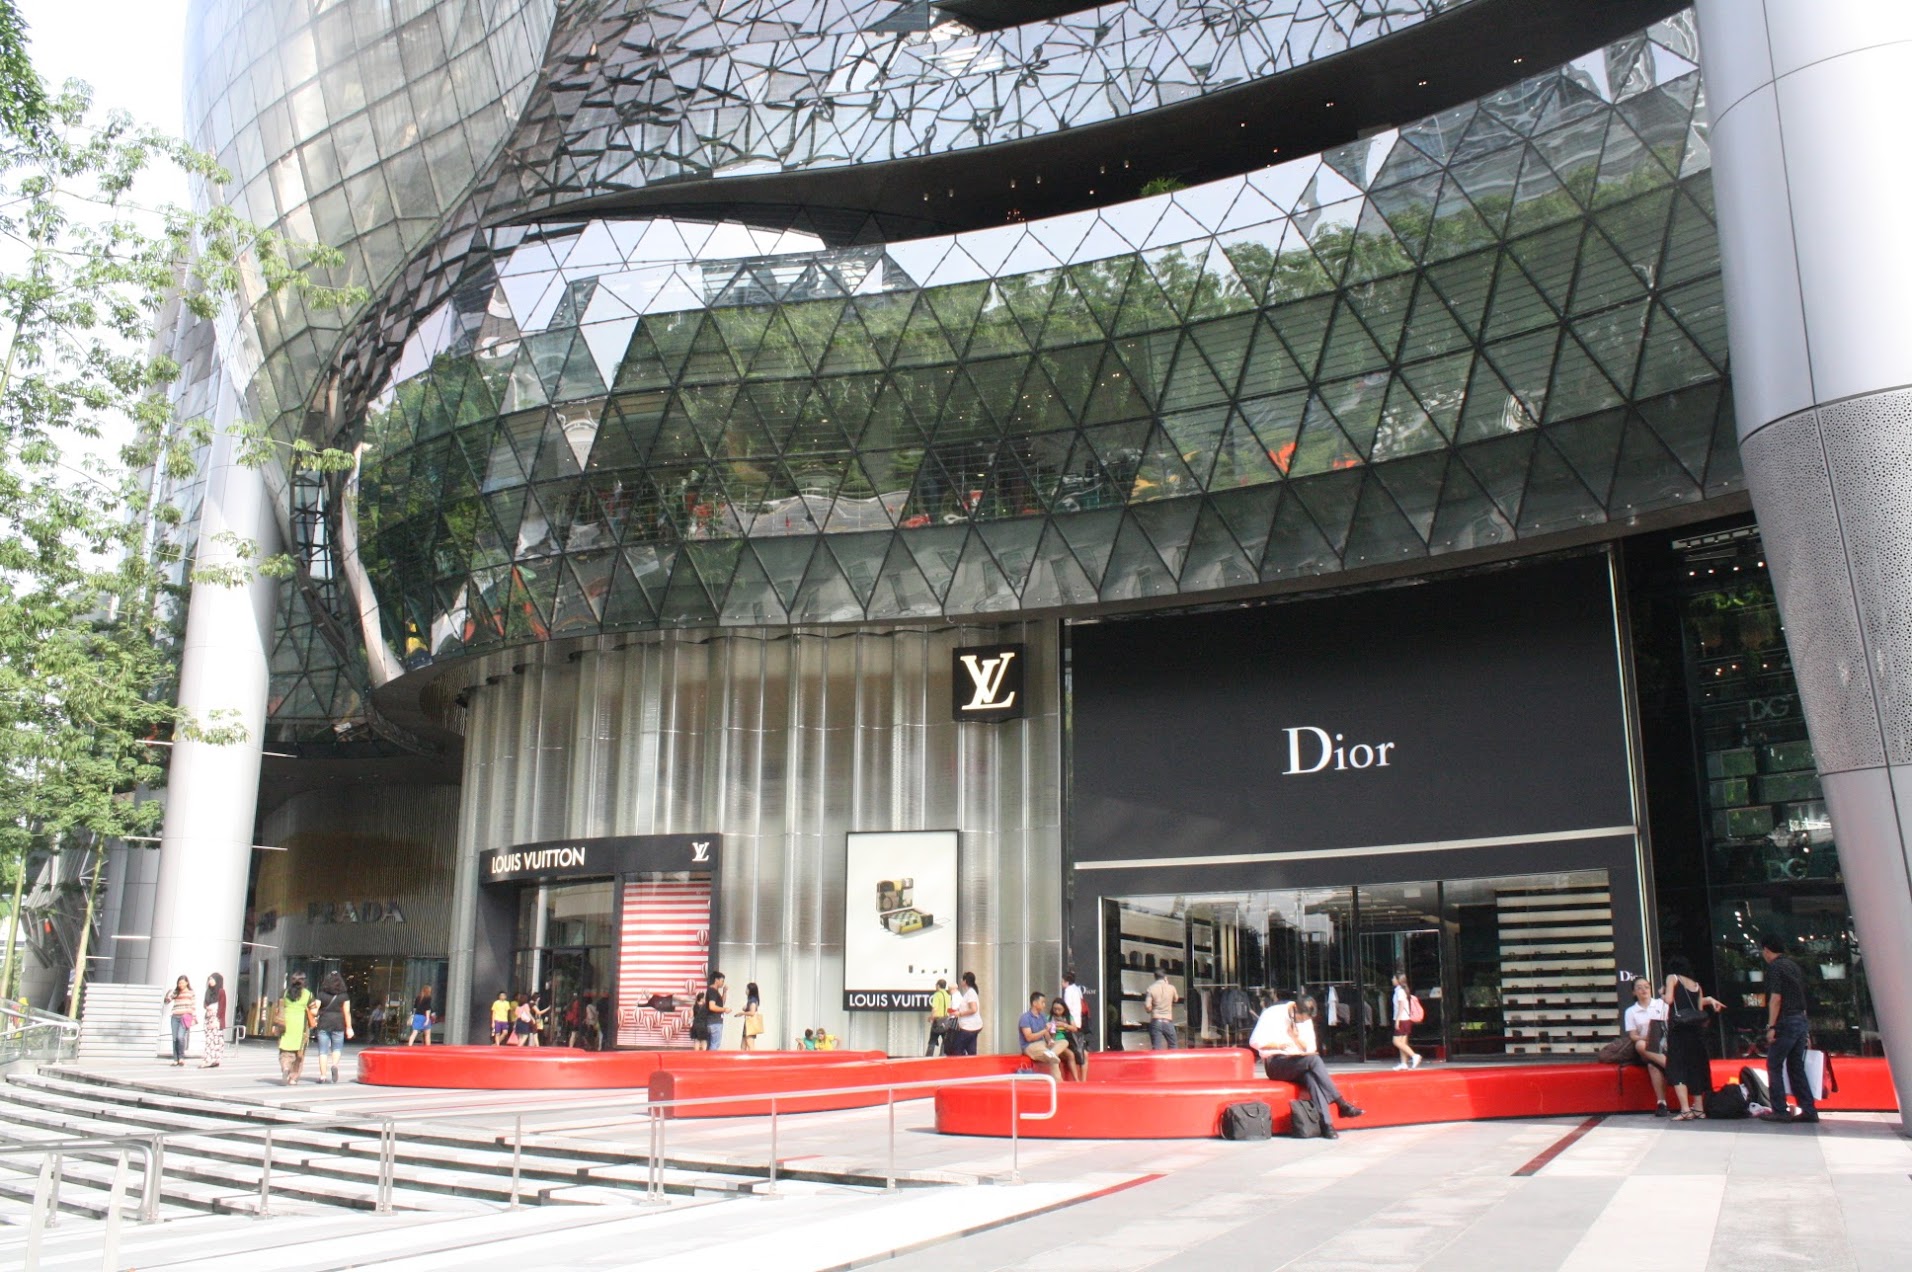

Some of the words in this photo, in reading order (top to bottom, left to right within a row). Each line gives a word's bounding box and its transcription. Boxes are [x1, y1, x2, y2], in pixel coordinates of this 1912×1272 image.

[1281, 726, 1395, 775] Dior
[491, 853, 521, 874] LOUIS
[525, 847, 586, 870] VUITTON
[307, 901, 405, 924] PRADA
[849, 994, 888, 1007] LOUIS
